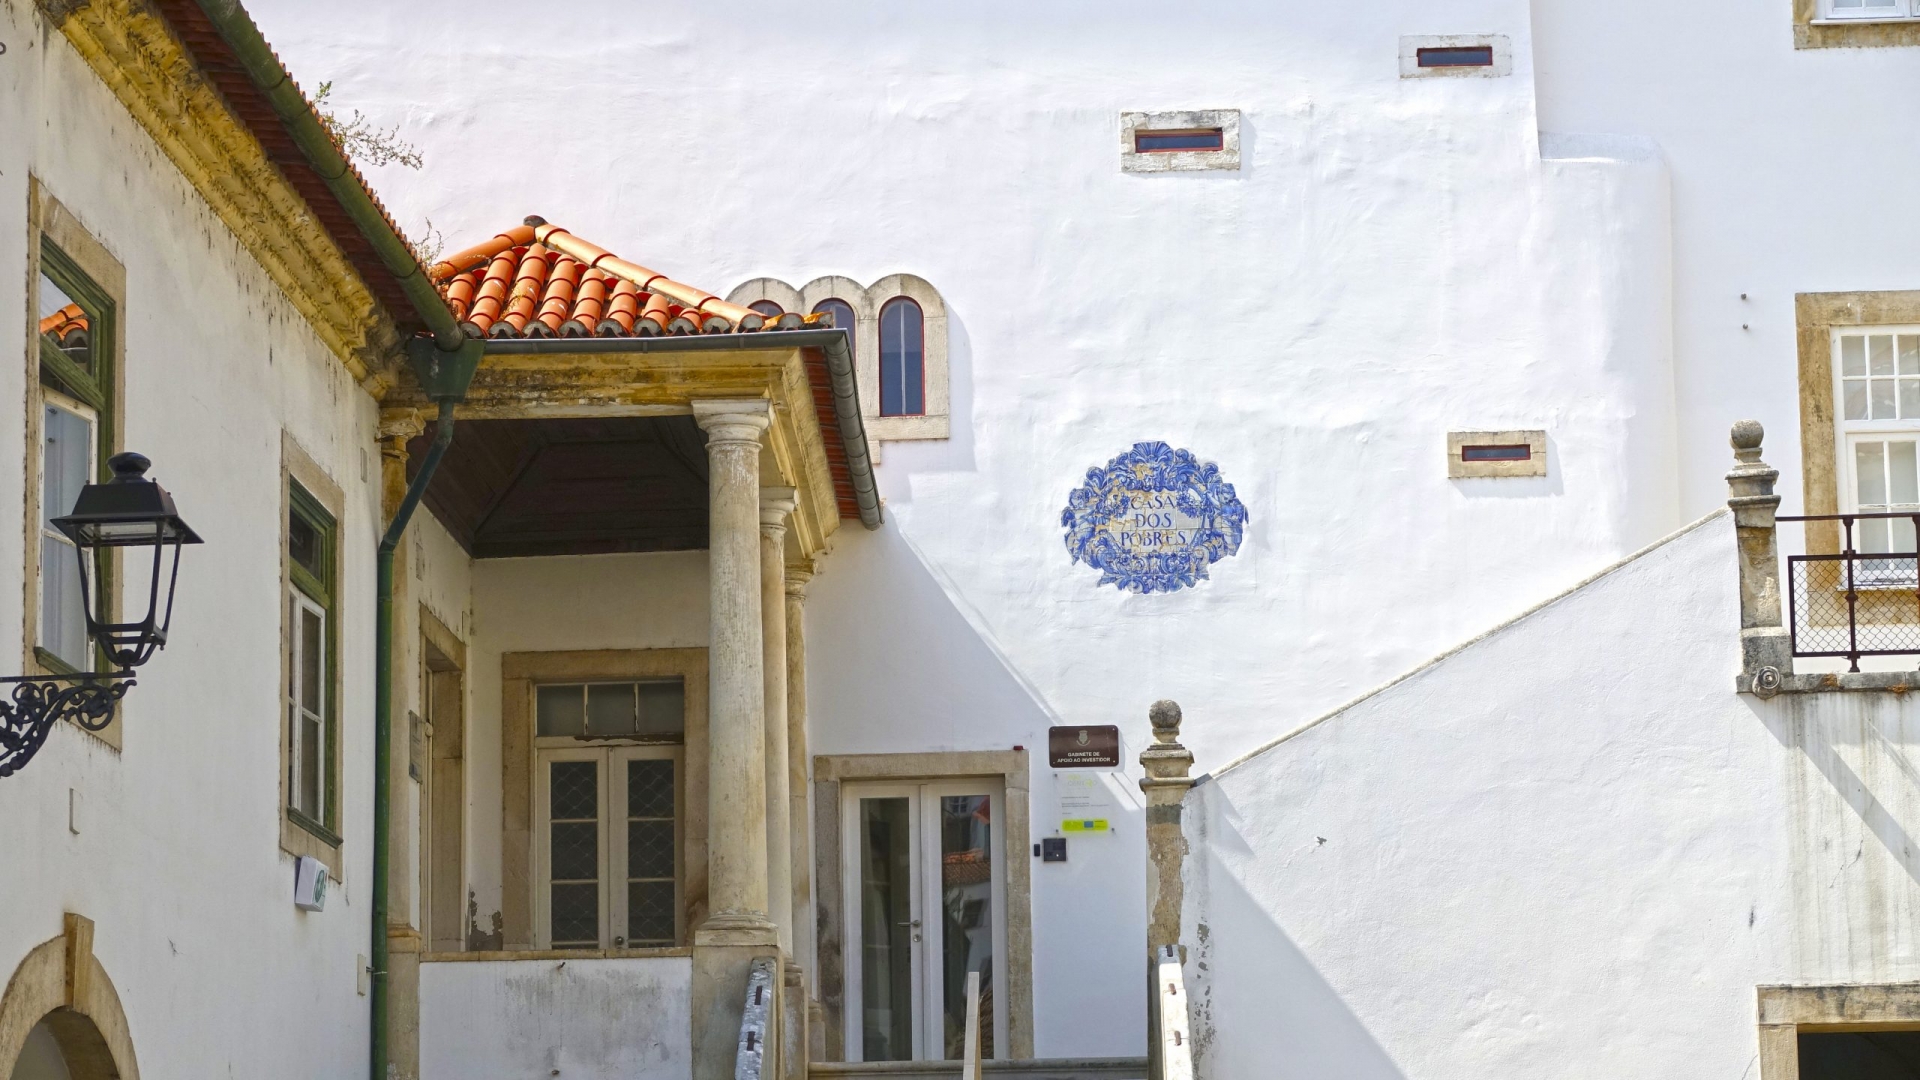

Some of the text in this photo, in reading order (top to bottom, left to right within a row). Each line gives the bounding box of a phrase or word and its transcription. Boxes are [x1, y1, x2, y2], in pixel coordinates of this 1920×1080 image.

[1130, 495, 1175, 509] CASA
[1135, 513, 1171, 527] DOS
[1121, 532, 1185, 546] POBRES
